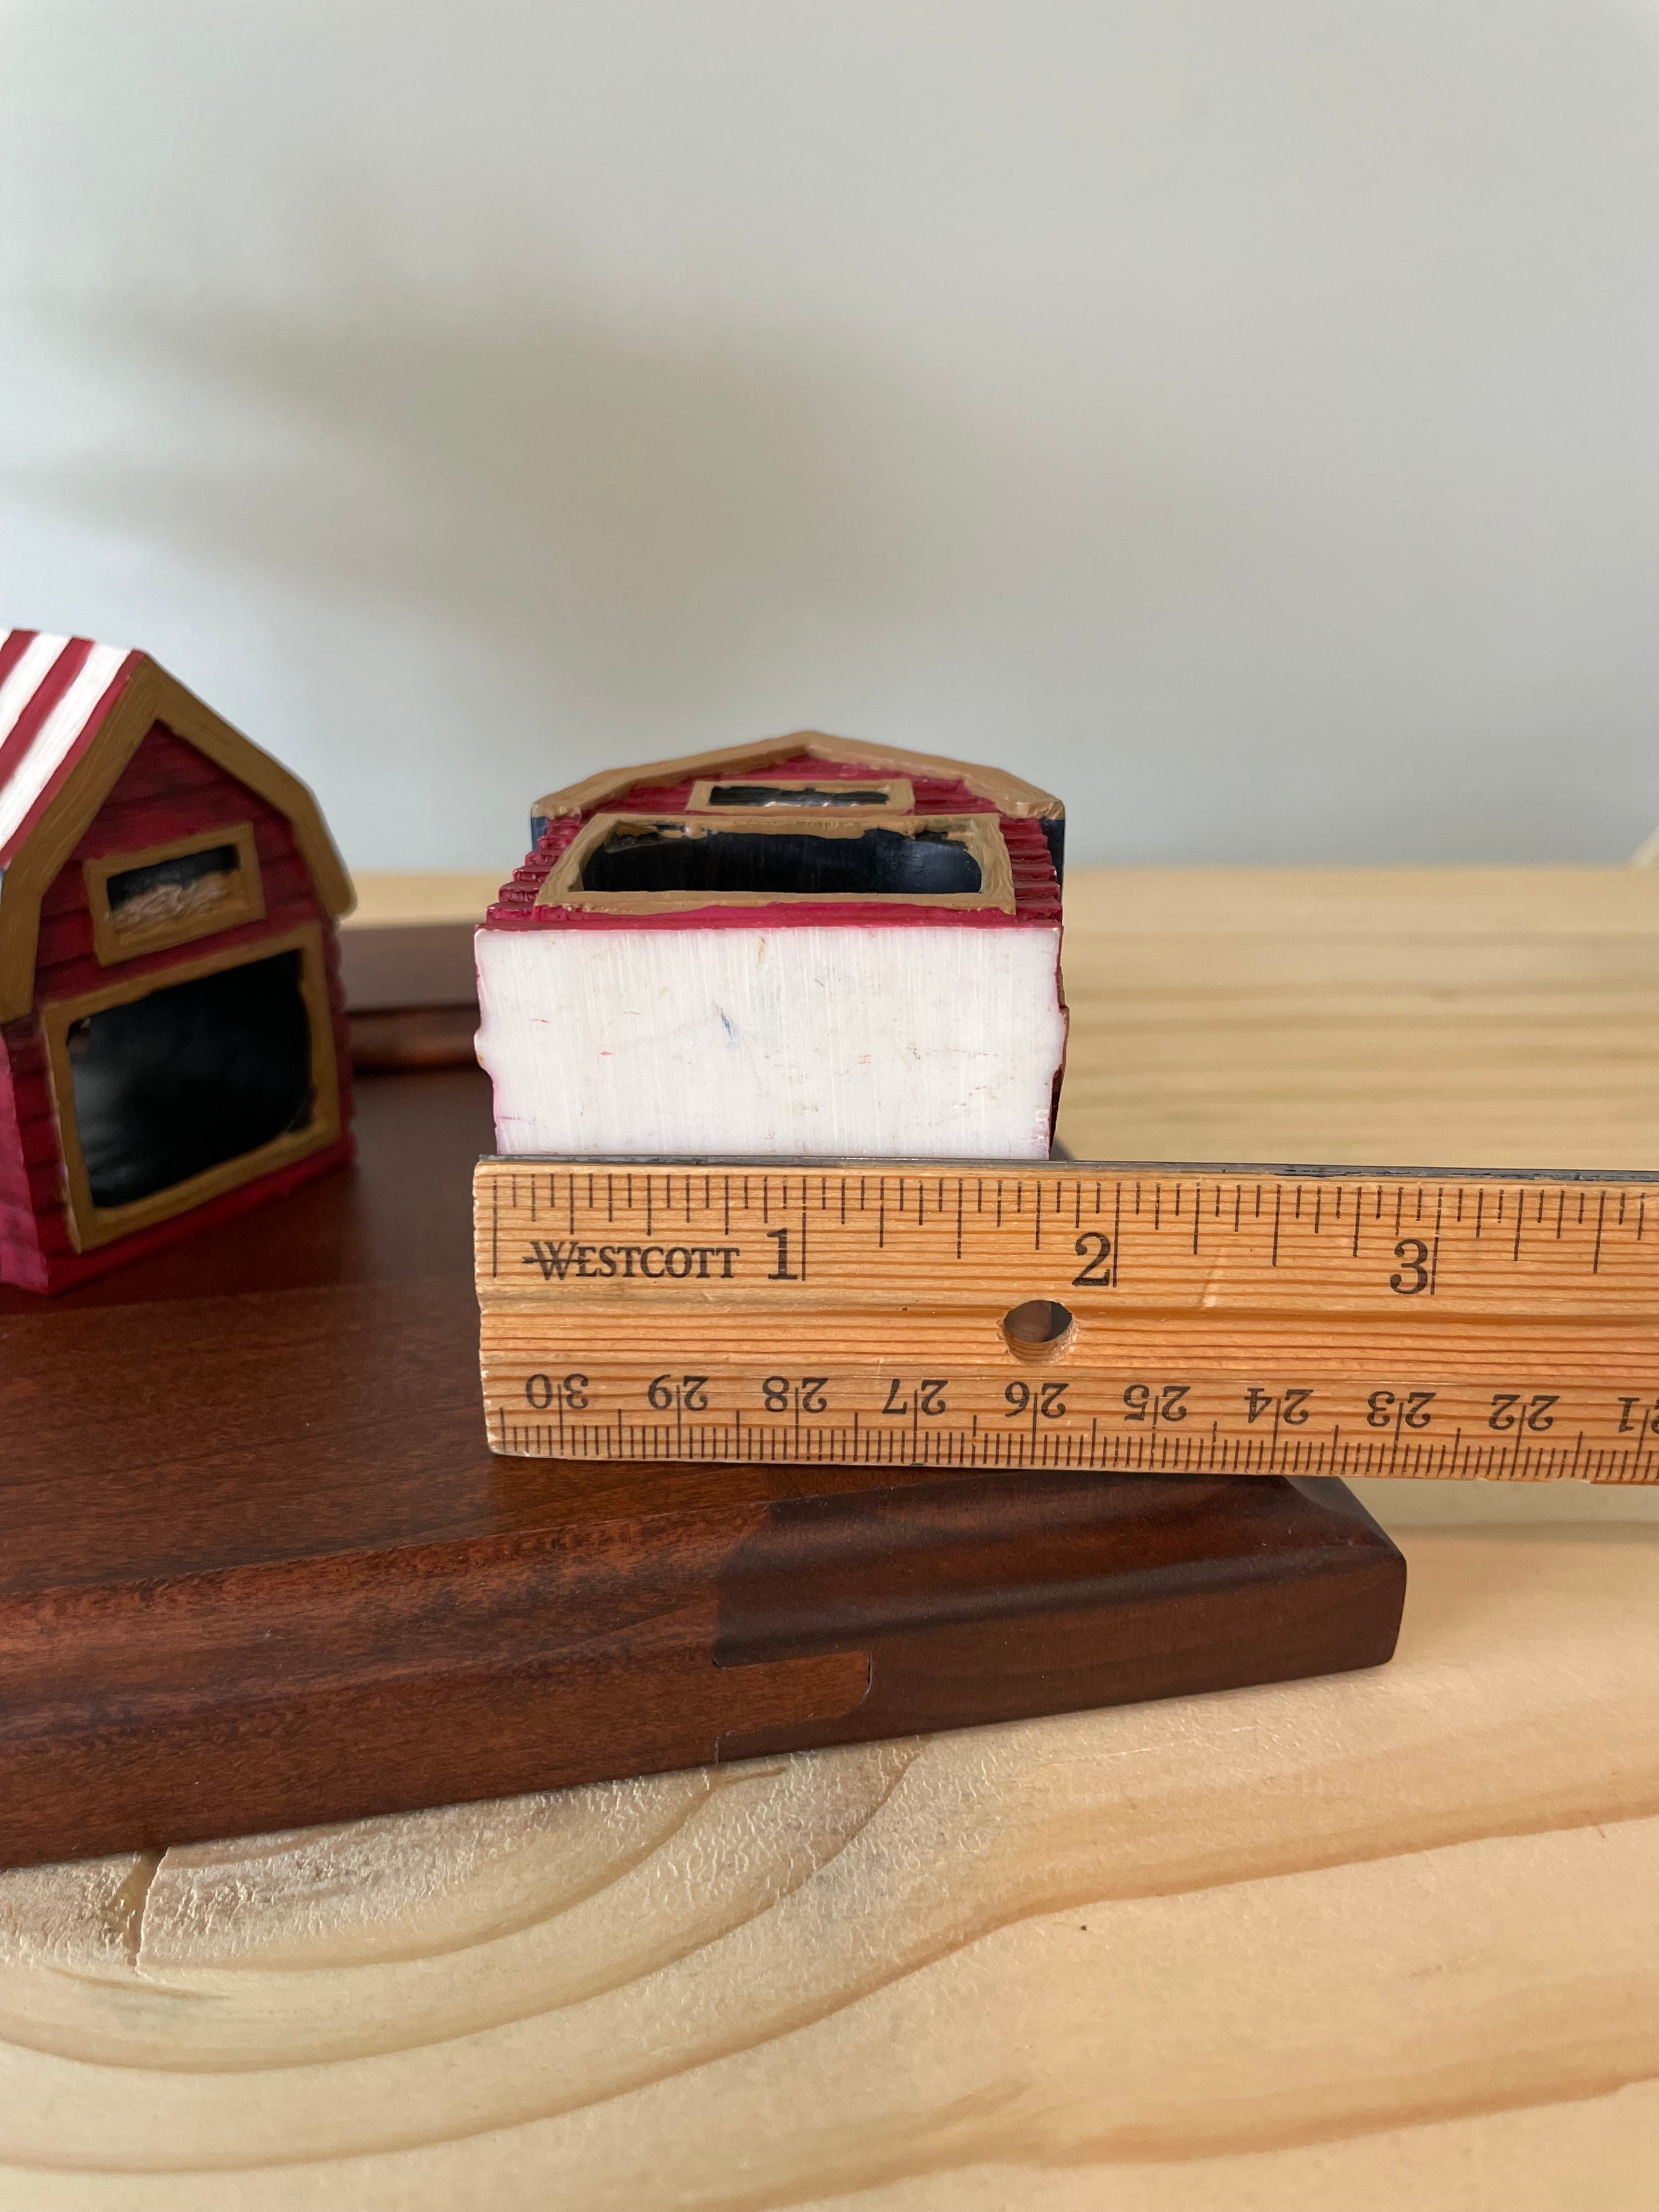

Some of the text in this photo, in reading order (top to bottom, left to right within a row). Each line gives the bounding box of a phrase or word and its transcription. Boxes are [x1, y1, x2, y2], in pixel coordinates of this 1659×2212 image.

[522, 1241, 740, 1280] WESTCOTT
[766, 1228, 798, 1280] 1
[1071, 1232, 1111, 1286] 2
[1390, 1239, 1428, 1295] 3
[525, 1373, 589, 1409] 30
[647, 1374, 709, 1411] 29
[761, 1376, 828, 1413] 28
[882, 1379, 949, 1415] 27
[1005, 1381, 1069, 1418] 26
[1123, 1384, 1190, 1421] 25
[1245, 1387, 1313, 1425] 24
[1367, 1391, 1436, 1427] 23
[1488, 1394, 1560, 1432] 22
